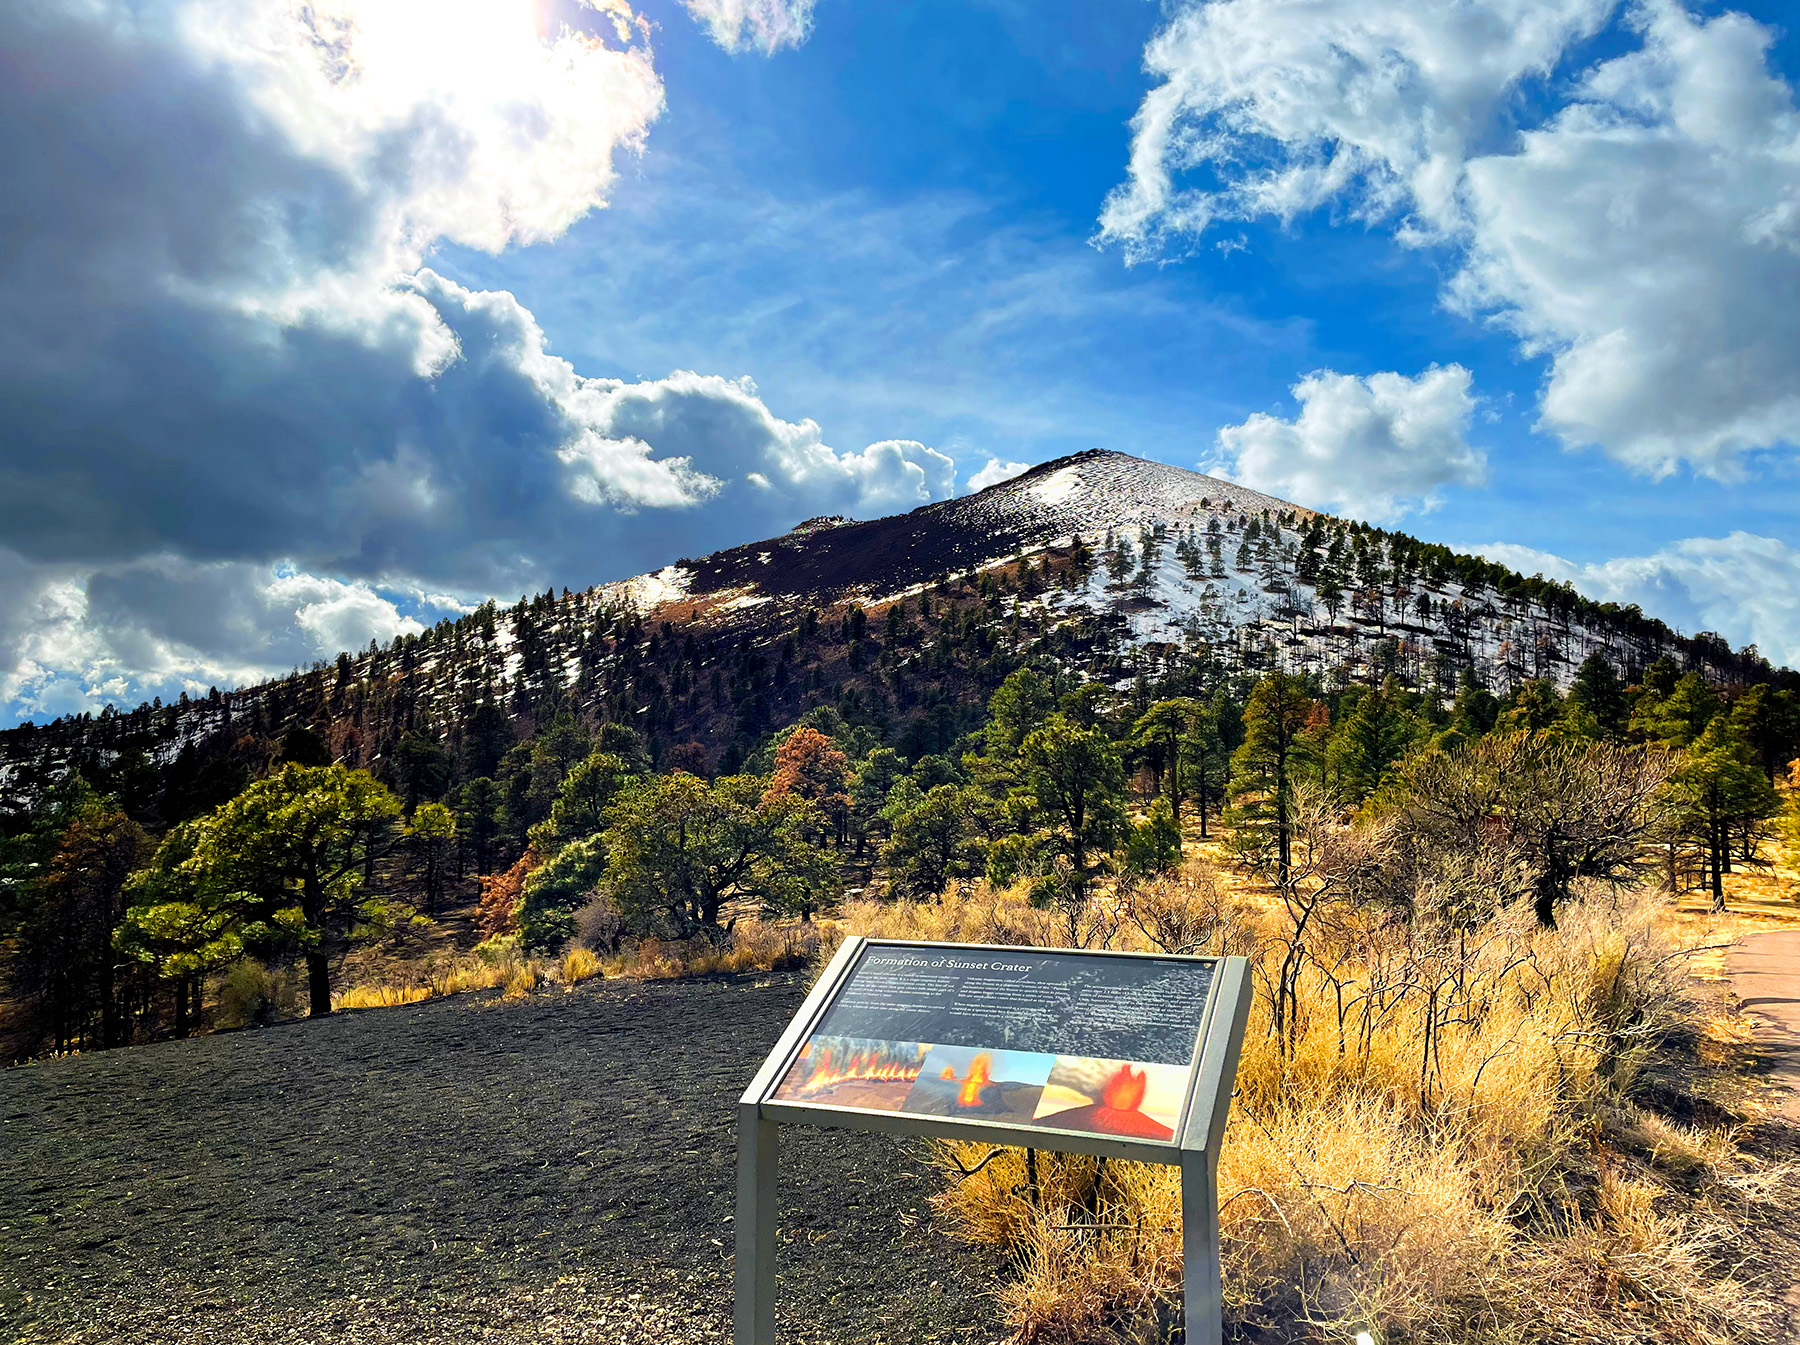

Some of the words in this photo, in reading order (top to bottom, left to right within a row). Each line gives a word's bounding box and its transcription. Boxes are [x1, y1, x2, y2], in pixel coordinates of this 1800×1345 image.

[865, 955, 929, 967] Formation
[931, 956, 946, 968] of
[946, 959, 988, 970] Sunset
[990, 961, 1033, 973] Crater
